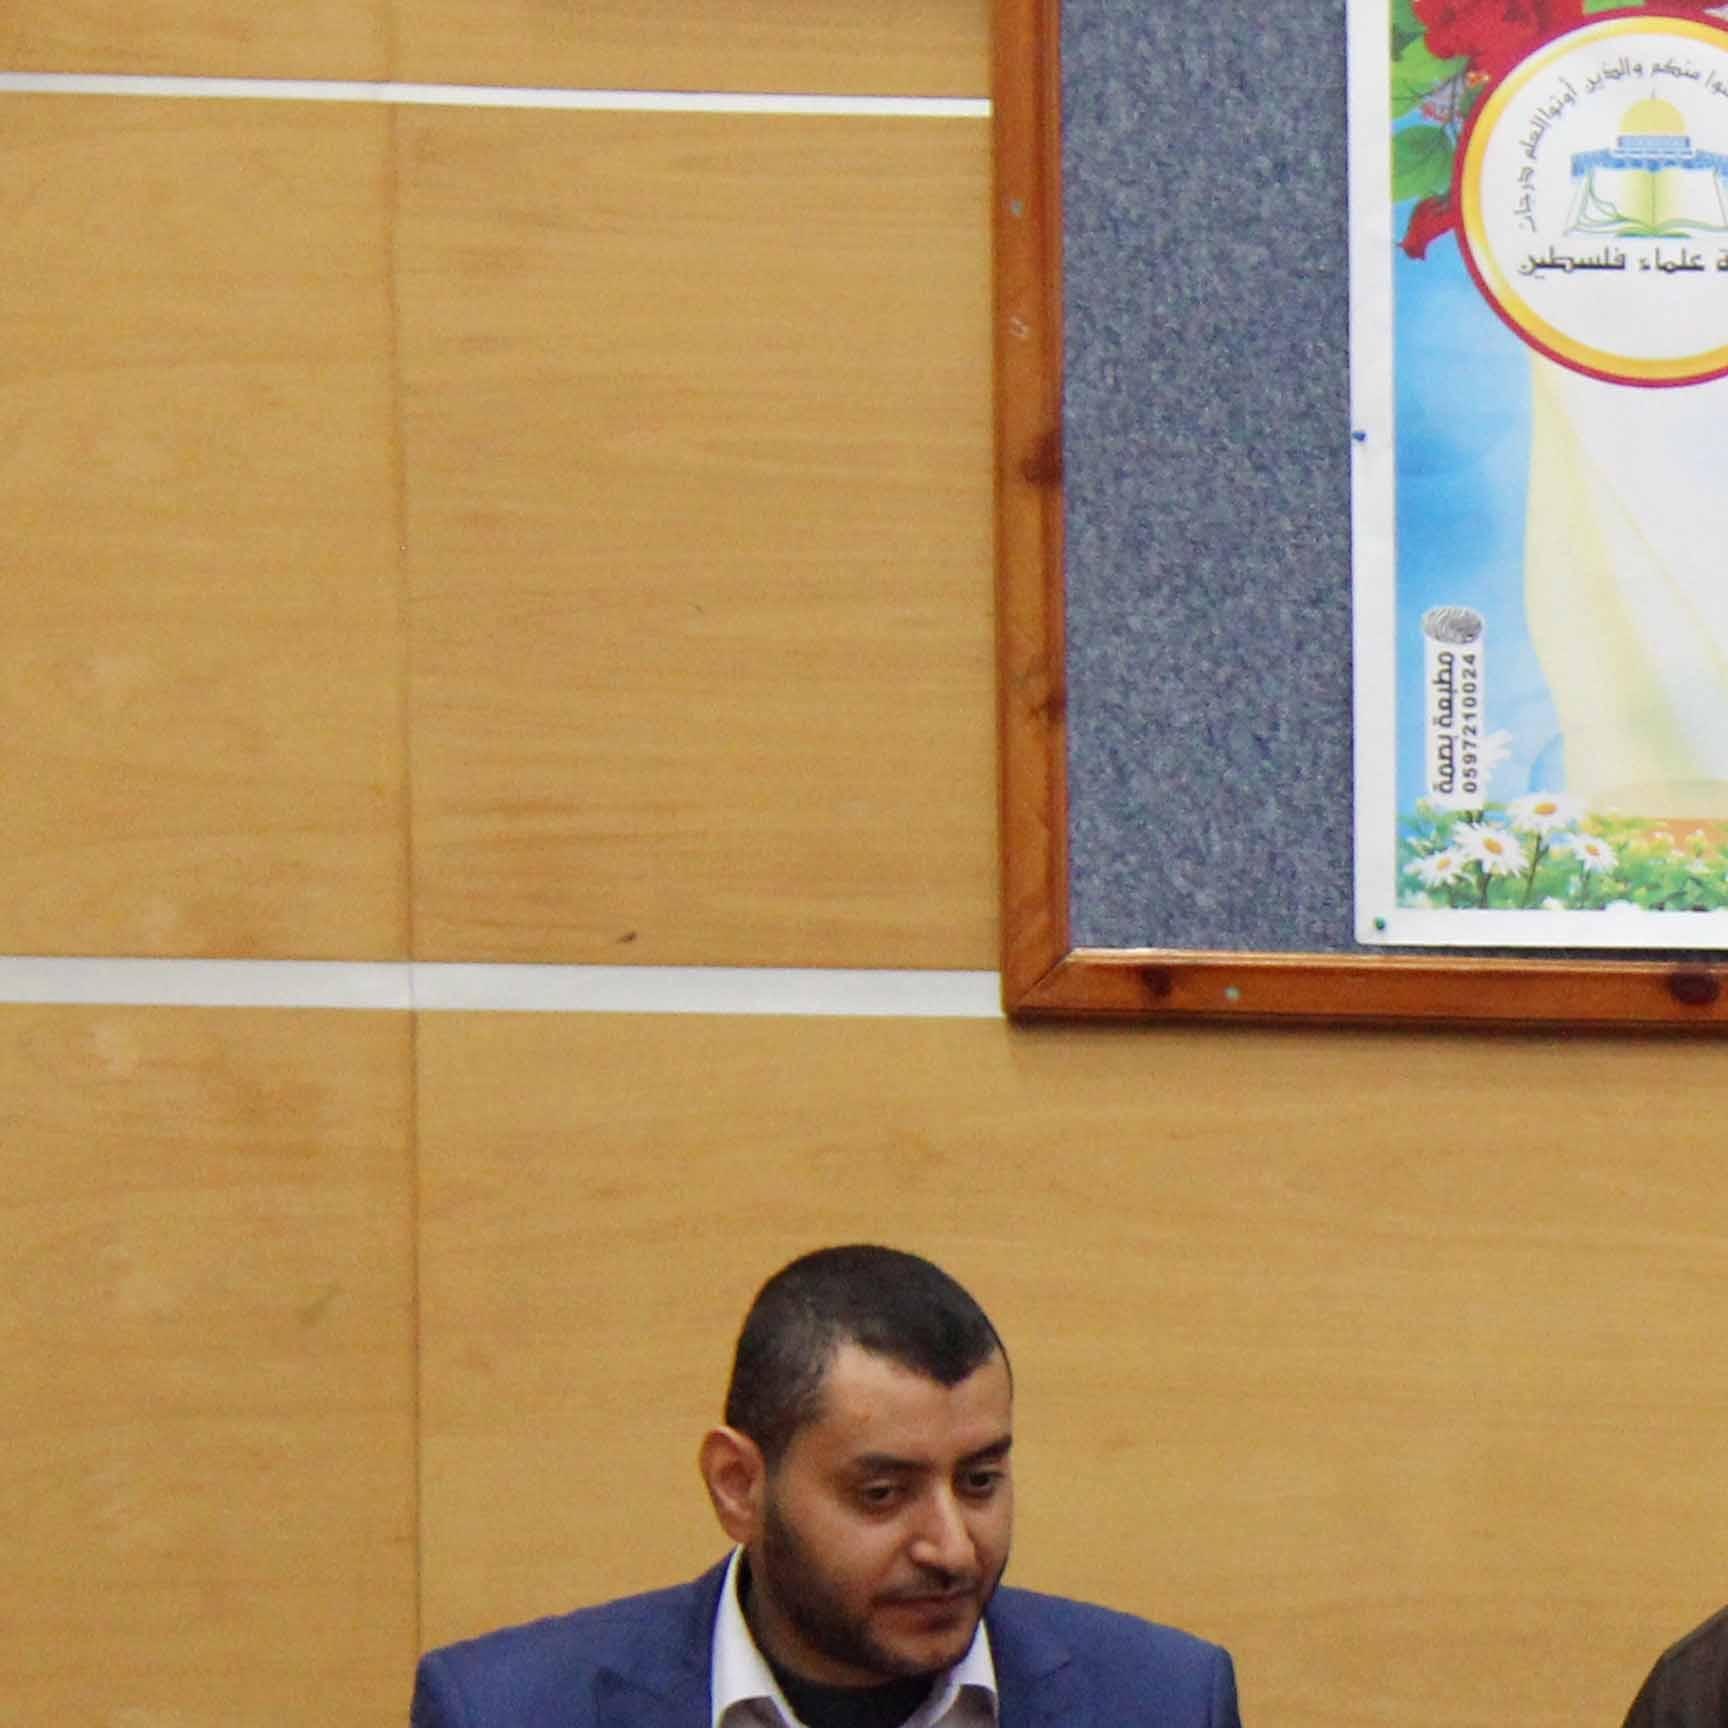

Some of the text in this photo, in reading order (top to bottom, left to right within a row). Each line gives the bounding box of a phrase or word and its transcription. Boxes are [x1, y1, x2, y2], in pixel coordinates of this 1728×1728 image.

[1517, 246, 1627, 282] فلسطين
[1638, 246, 1705, 275] علماء
[1433, 651, 1456, 729] مطبعة
[1462, 653, 1478, 794] 0597210024
